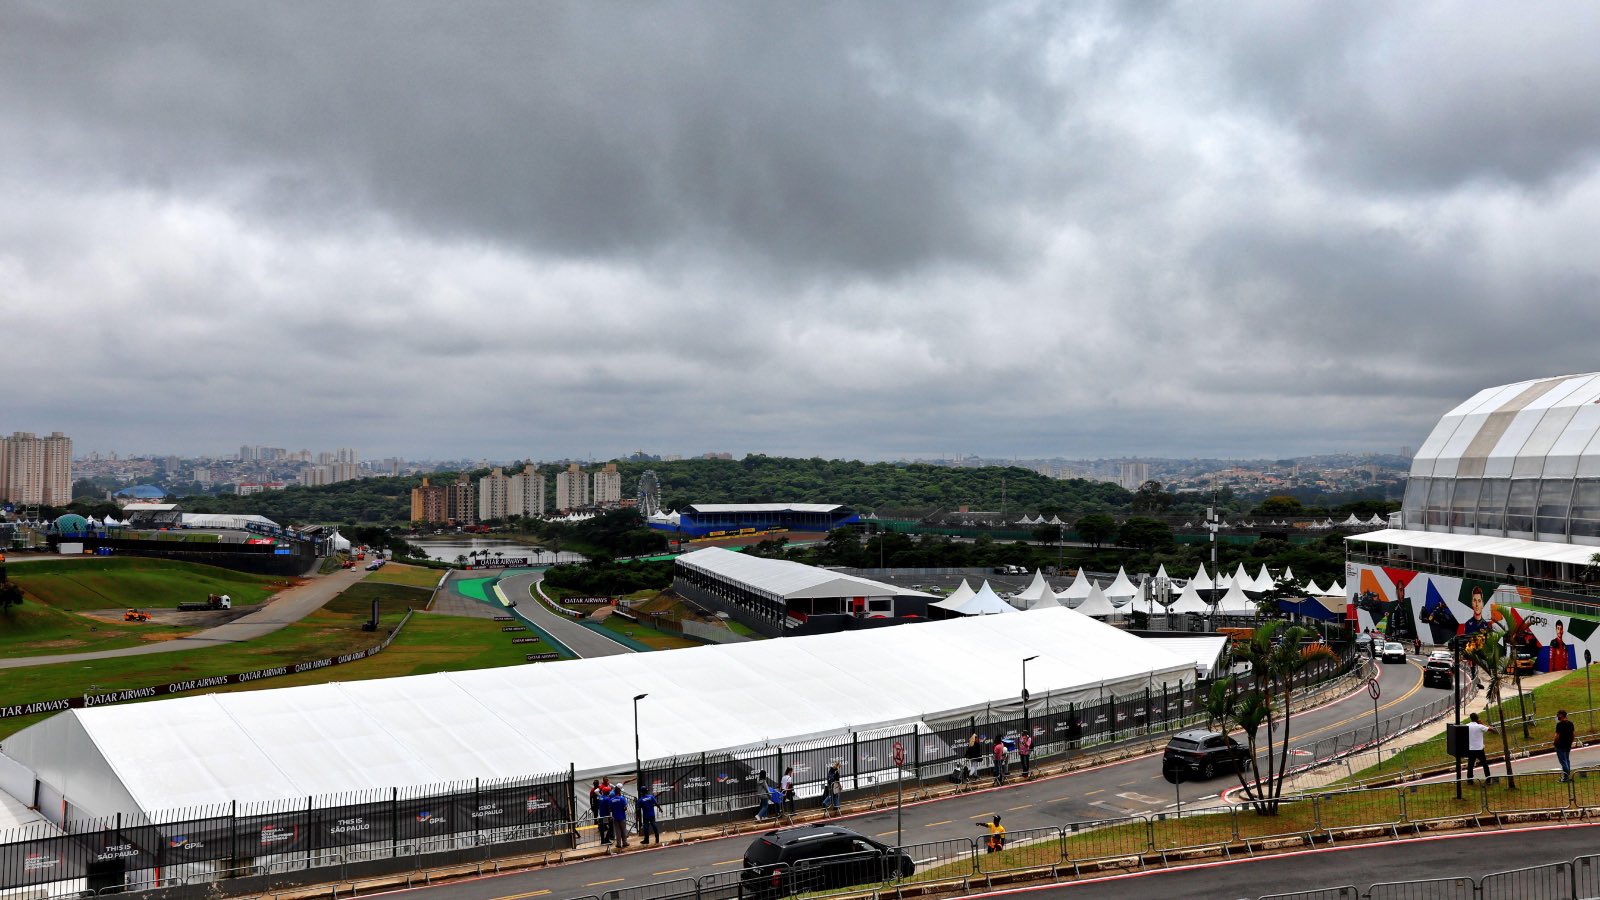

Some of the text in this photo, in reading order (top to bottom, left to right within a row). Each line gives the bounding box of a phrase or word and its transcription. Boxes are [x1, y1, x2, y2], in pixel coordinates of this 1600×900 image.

[481, 558, 499, 566] QATAR
[295, 657, 332, 672] QATAR AIRWAYS
[239, 666, 287, 682] QATAR AIRWAYS
[169, 675, 228, 693] QATAR AIRWAYS
[86, 686, 155, 706] QATAR AIRWAYS
[0, 699, 69, 718] TAR AIRWAYS
[484, 808, 503, 816] PAULO
[330, 823, 370, 834] SÃO PAULO
[114, 849, 139, 858] PAULO
